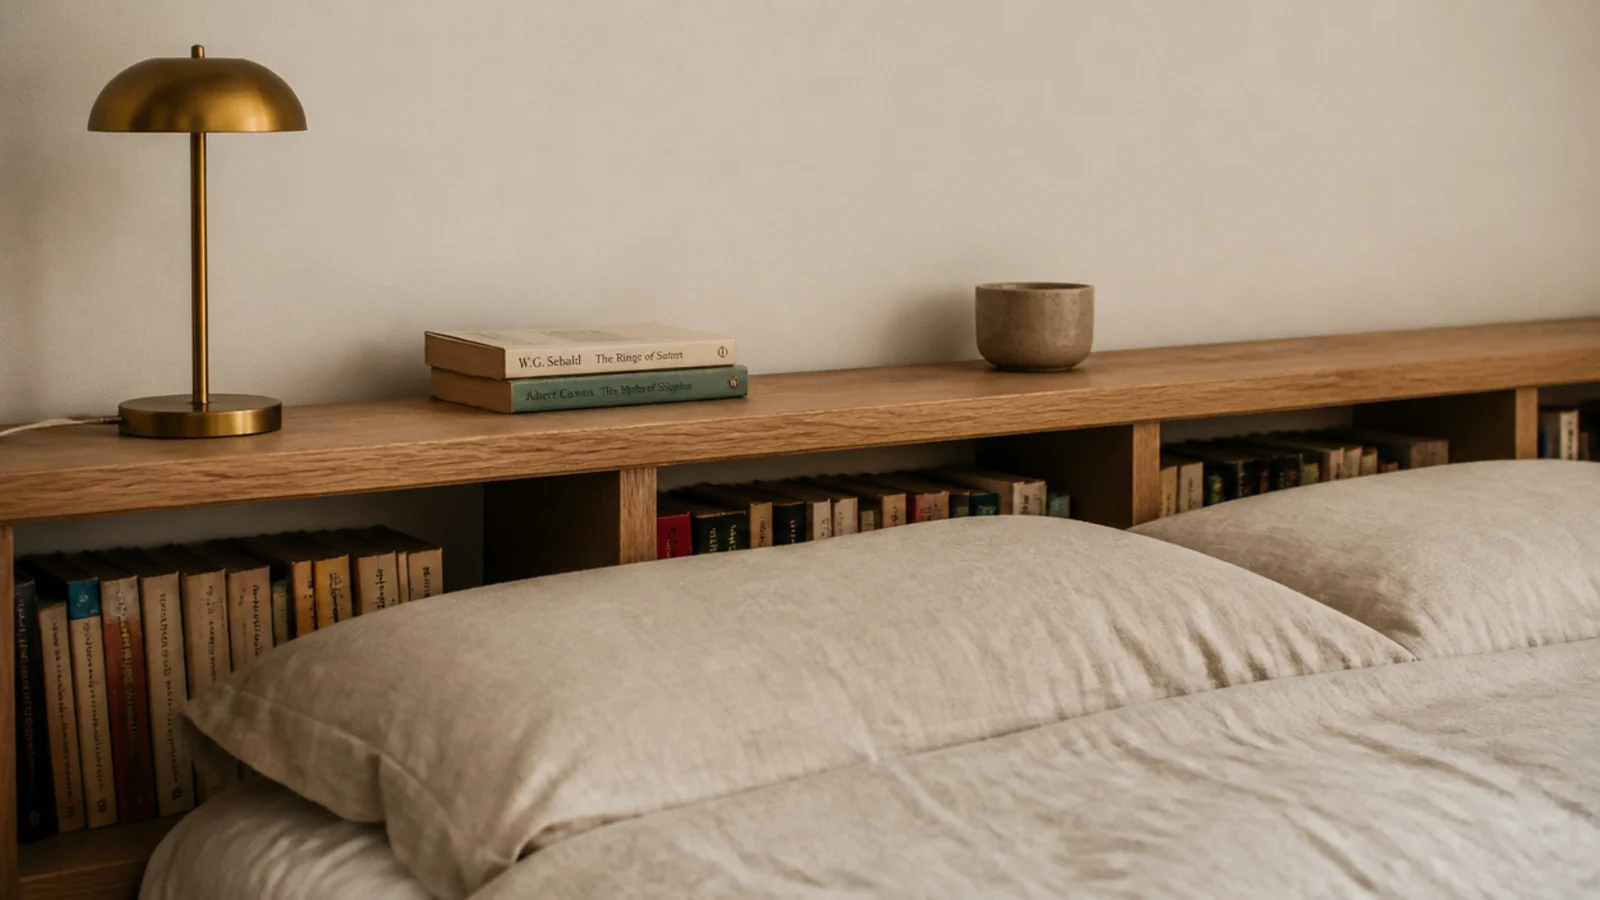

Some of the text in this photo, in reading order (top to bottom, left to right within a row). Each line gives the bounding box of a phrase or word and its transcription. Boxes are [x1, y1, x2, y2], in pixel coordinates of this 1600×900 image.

[518, 356, 545, 368] W.G.
[547, 354, 581, 367] Sebald
[595, 353, 614, 364] The
[616, 352, 642, 365] Rings
[644, 350, 655, 362] of
